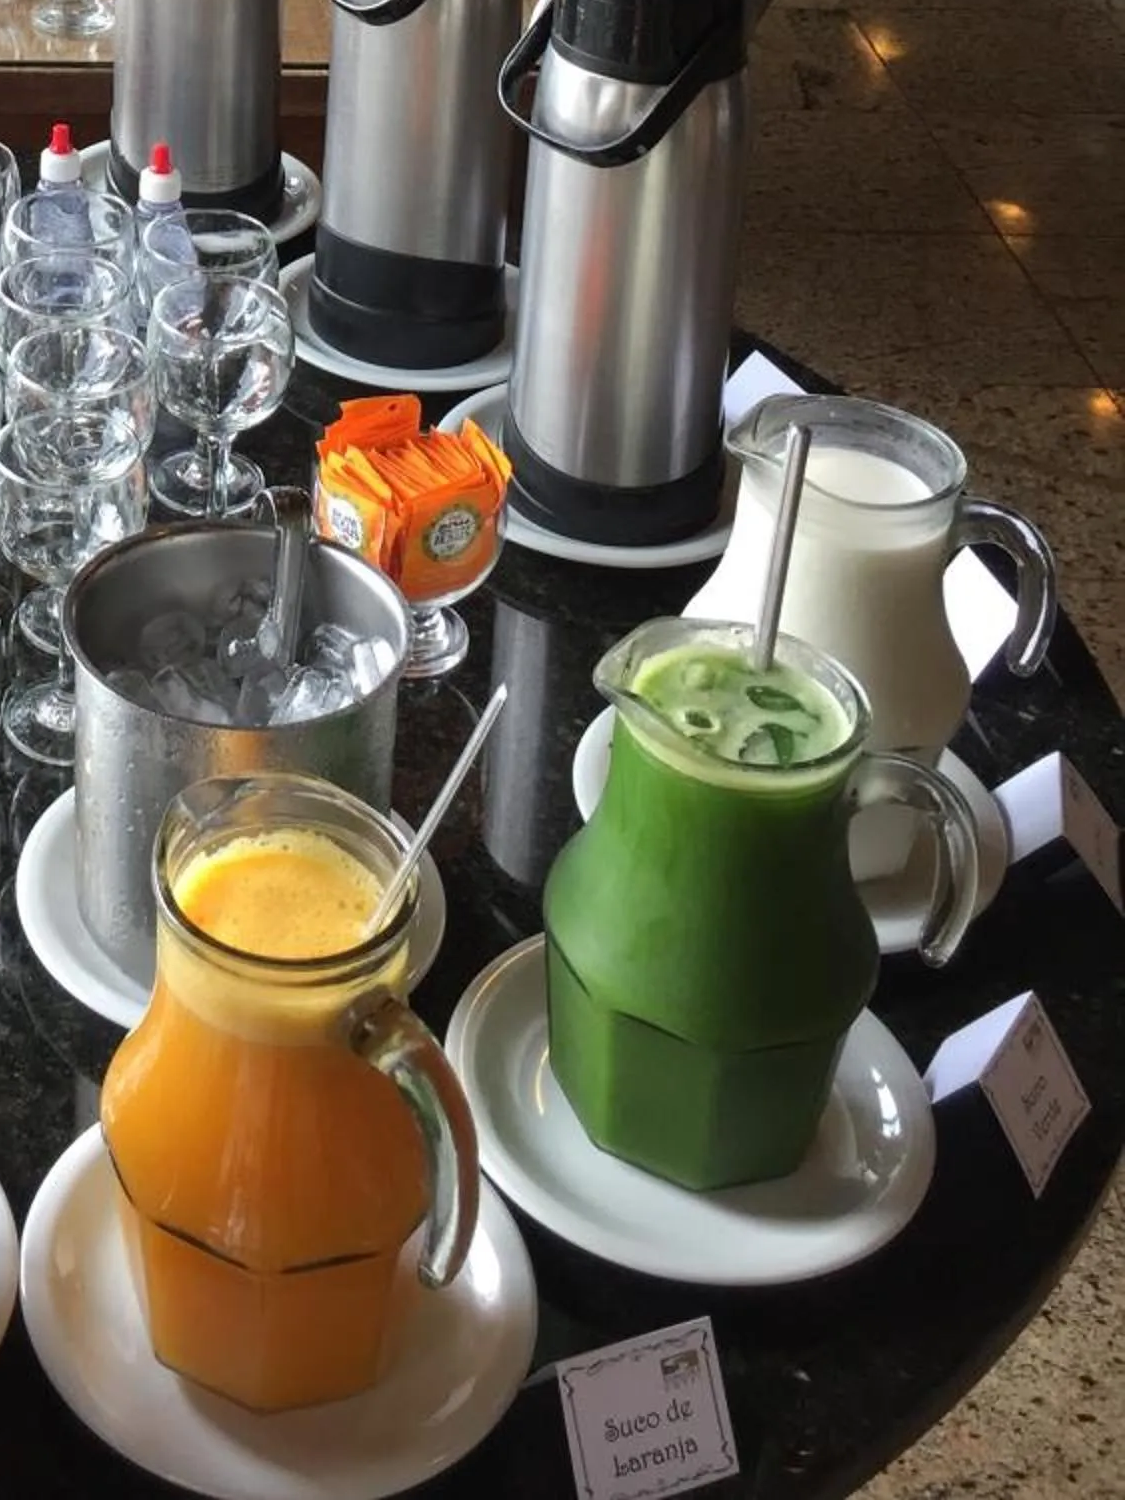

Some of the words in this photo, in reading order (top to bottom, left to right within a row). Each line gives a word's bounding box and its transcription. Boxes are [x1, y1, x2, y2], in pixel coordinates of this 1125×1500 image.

[603, 1411, 661, 1443] Suco
[666, 1397, 694, 1423] de
[613, 1436, 699, 1478] Laranja
